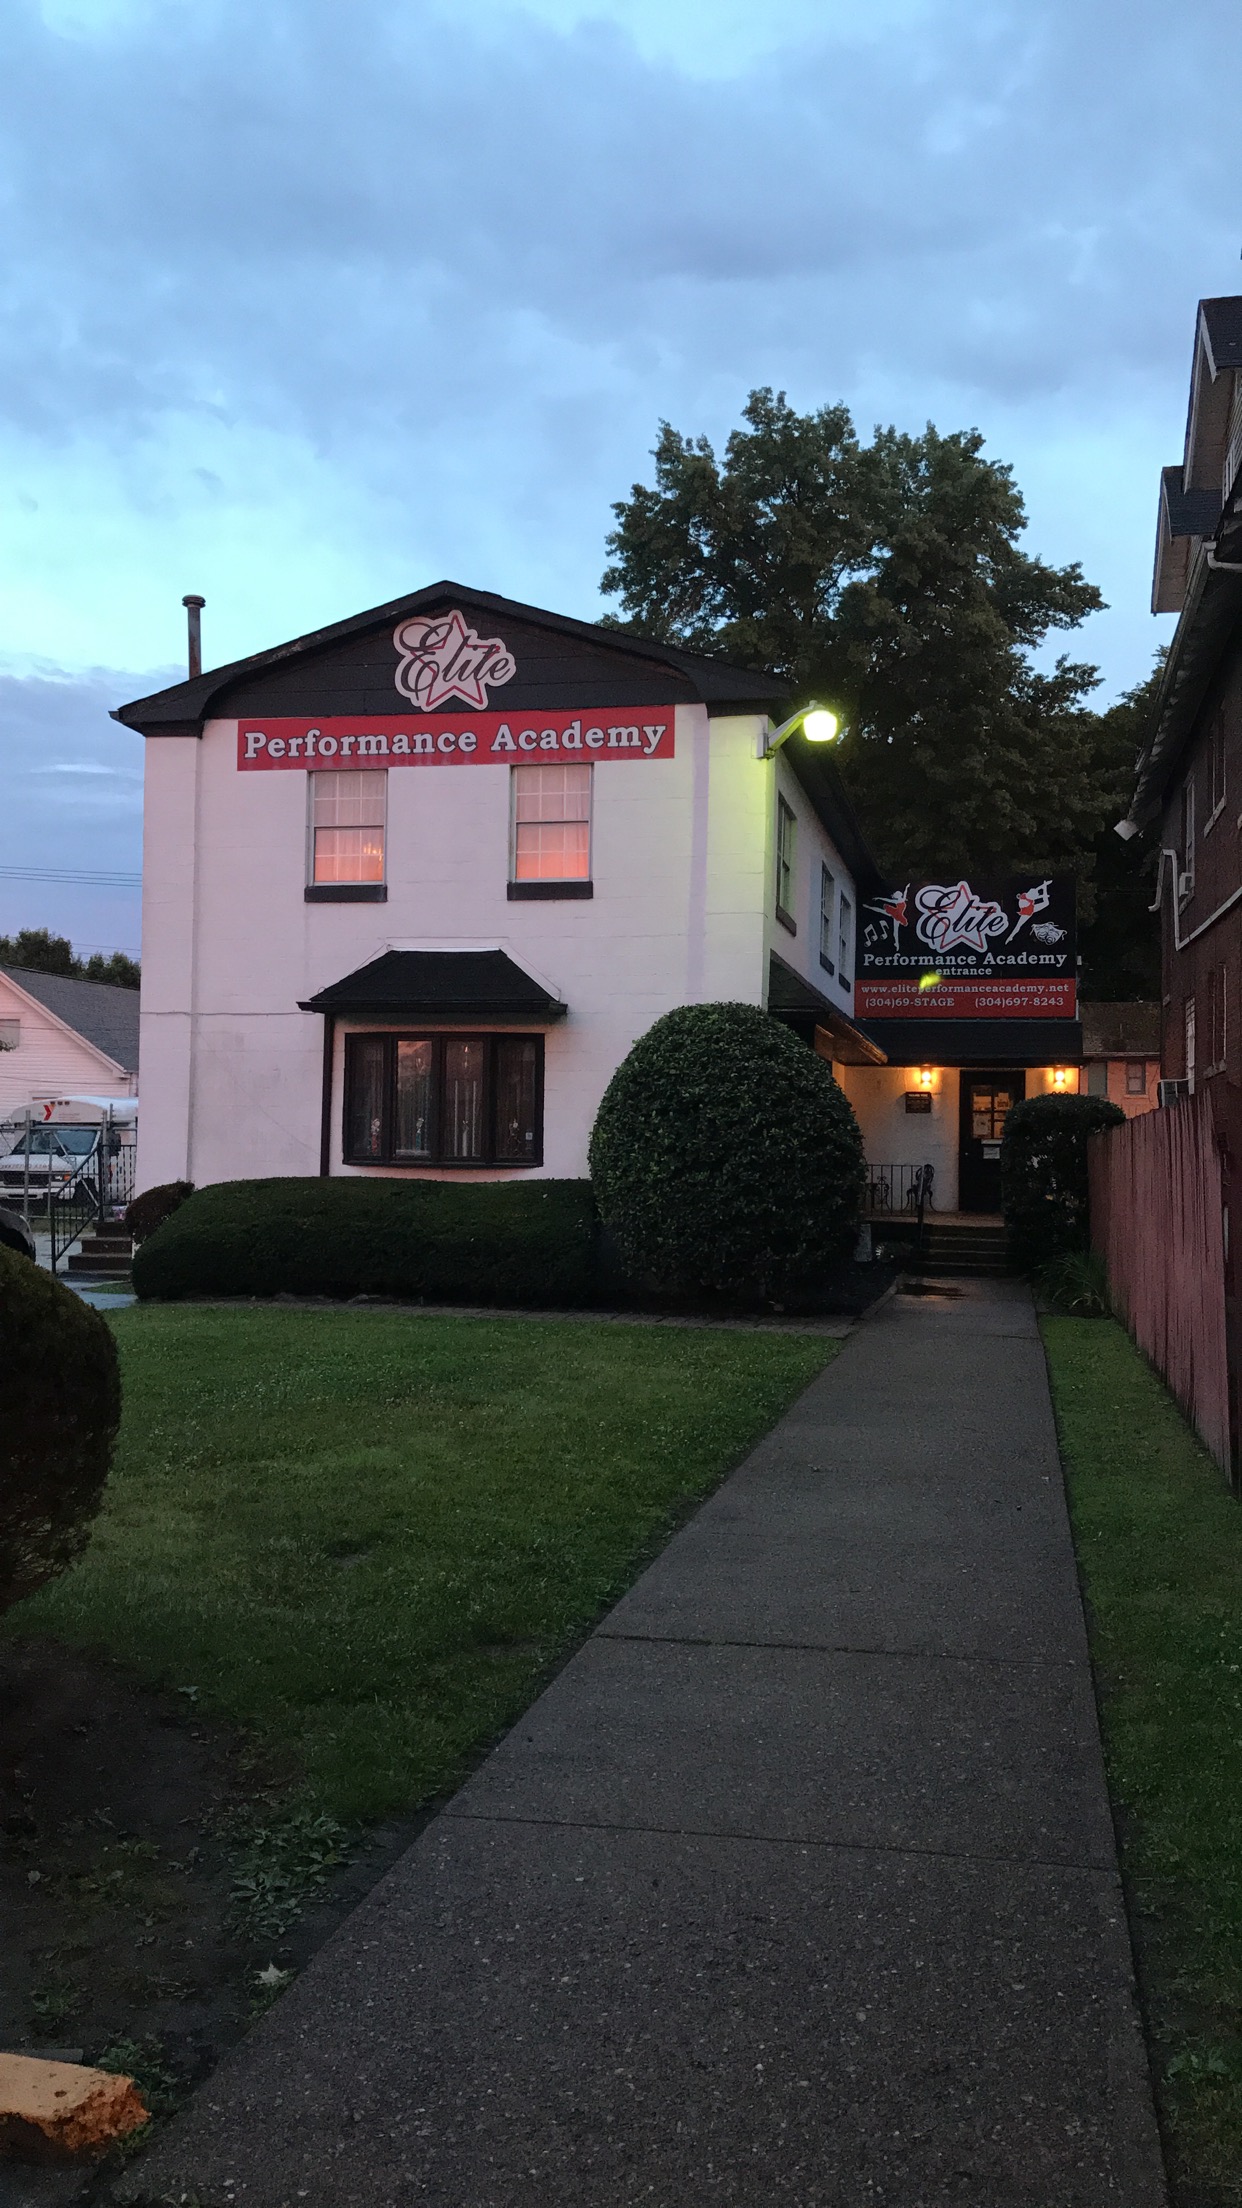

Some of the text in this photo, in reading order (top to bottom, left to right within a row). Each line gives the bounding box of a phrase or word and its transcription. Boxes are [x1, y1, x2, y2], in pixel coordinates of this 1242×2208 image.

[399, 621, 511, 701] Elite
[243, 719, 667, 760] Performance Academy
[918, 888, 1005, 945] Elite
[863, 951, 1068, 968] Performance Academy
[935, 966, 993, 976] entrance
[865, 997, 1065, 1008] (304)69-STAGE (304)697-8243
